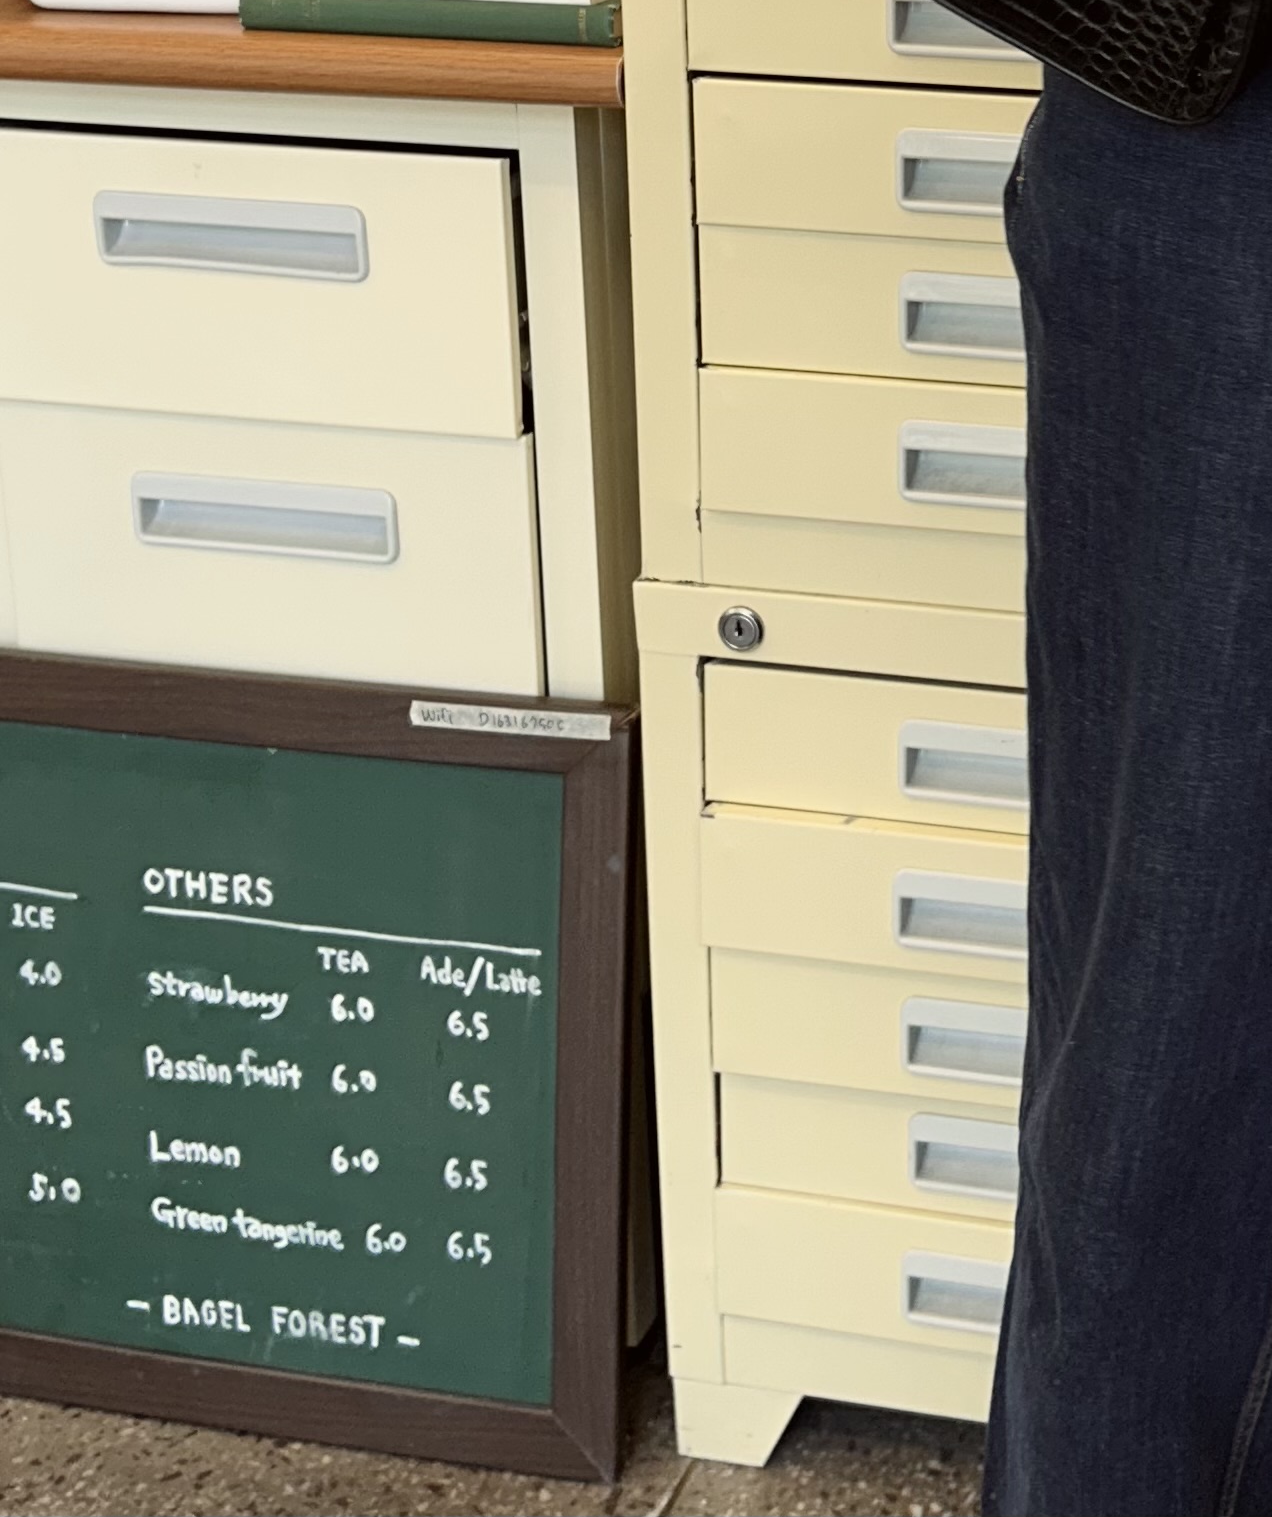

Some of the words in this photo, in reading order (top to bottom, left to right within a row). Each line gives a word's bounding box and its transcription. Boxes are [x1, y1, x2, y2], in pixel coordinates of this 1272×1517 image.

[143, 868, 273, 907] OTHERS
[12, 903, 55, 930] ICE
[19, 958, 62, 987] 4.0
[317, 946, 370, 973] TEA
[420, 955, 542, 997] Ade/Latte
[331, 994, 375, 1022] 6.0
[447, 1010, 490, 1041] 6.5
[22, 1035, 66, 1063] 4.5
[146, 1045, 232, 1085] Passion
[236, 1048, 302, 1090] fruit
[332, 1064, 377, 1093] 6.0
[449, 1081, 491, 1116] 6.5
[25, 1096, 72, 1129] 4.5
[149, 1130, 241, 1168] Lemon
[331, 1145, 379, 1174] 6.0
[444, 1157, 488, 1191] 6.5
[29, 1172, 81, 1203] 5.0
[151, 1197, 228, 1233] Green
[232, 1208, 345, 1250] tangerine
[366, 1223, 407, 1255] 6.0
[447, 1231, 493, 1265] 6.5
[162, 1295, 251, 1332] BAGEL
[271, 1306, 385, 1348] FOREST
